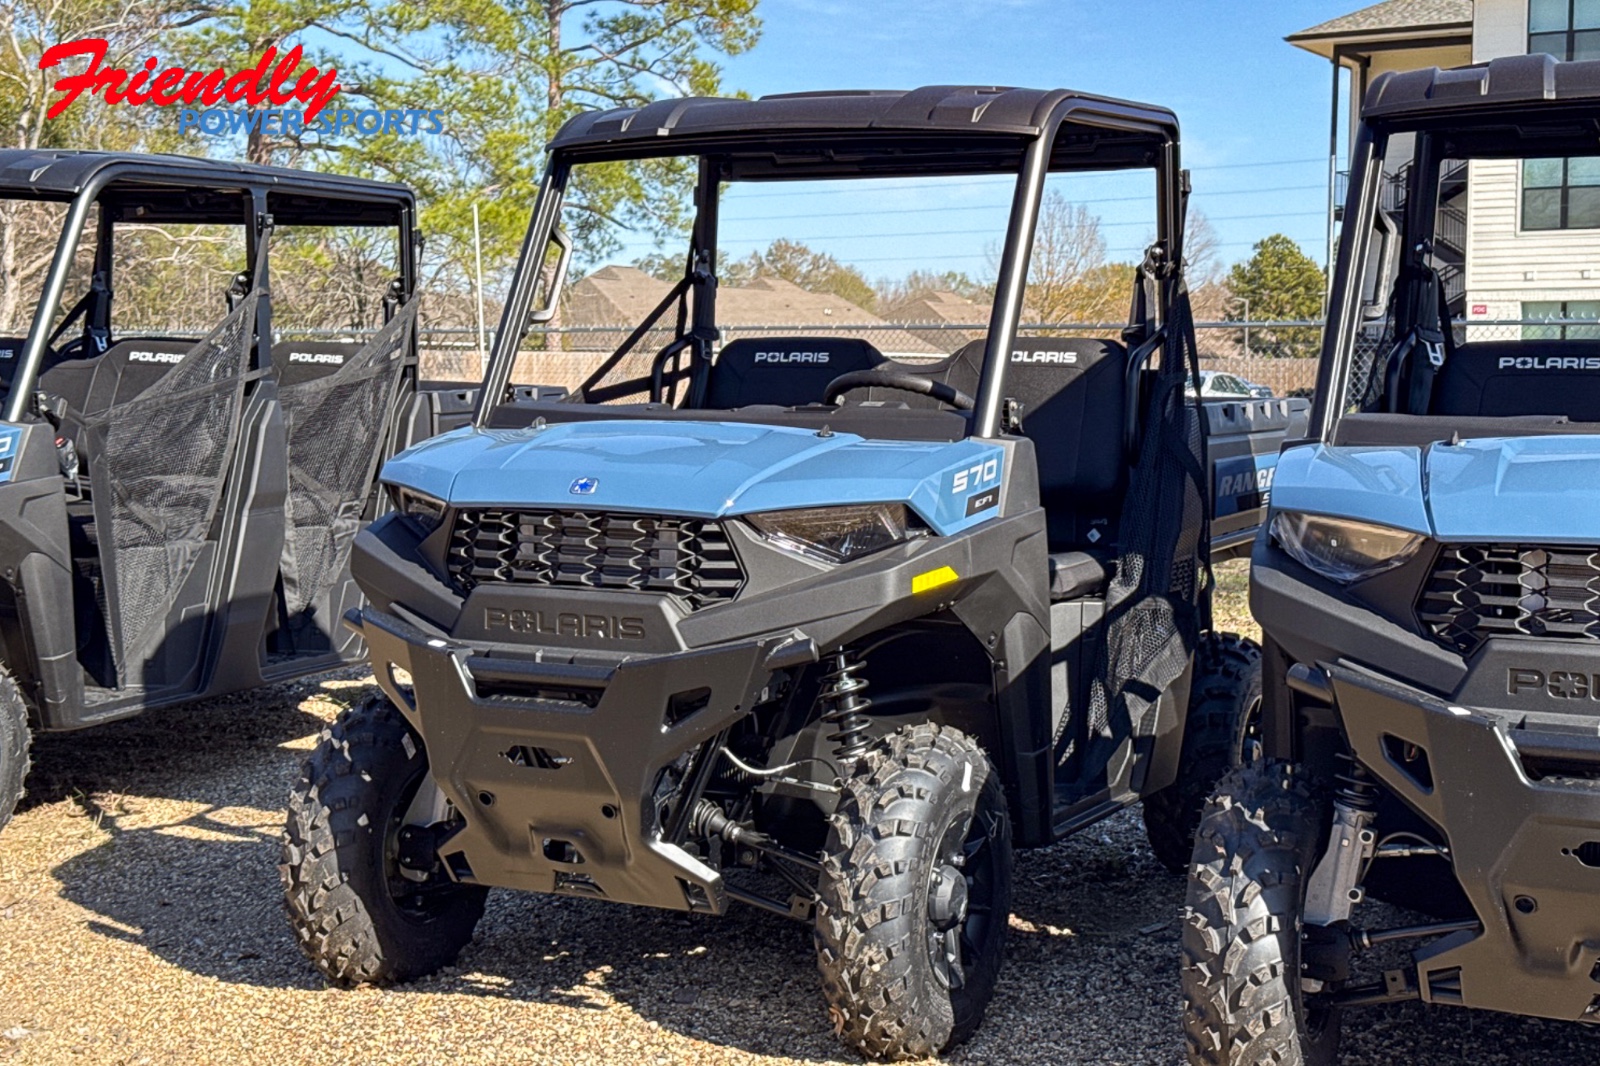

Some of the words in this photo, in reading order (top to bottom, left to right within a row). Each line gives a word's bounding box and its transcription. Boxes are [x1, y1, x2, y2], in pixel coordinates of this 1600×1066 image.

[289, 352, 344, 363] POLARIS
[754, 351, 830, 363] POLARIS
[1010, 351, 1077, 363] OLARIS
[1498, 357, 1600, 369] POLARIS
[952, 459, 998, 494] 570
[484, 607, 646, 640] POLARIS
